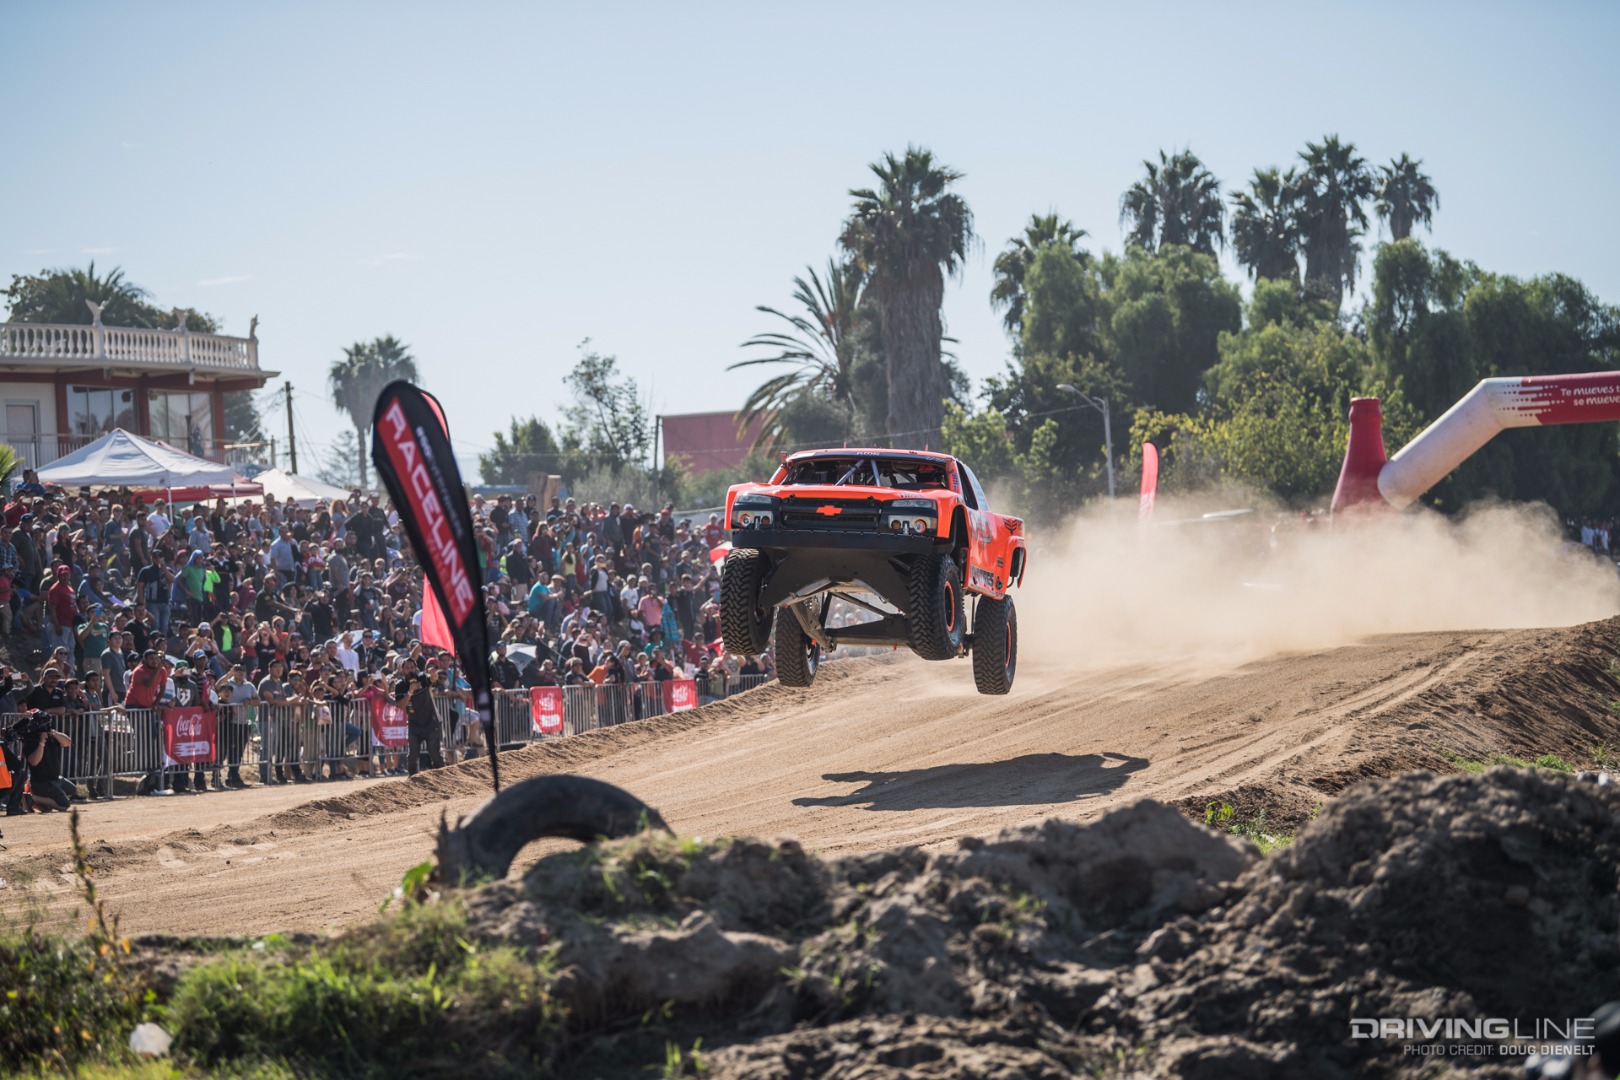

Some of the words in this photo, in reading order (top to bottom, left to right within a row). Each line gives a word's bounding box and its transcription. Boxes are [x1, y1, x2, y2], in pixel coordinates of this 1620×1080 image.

[1560, 388, 1571, 397] Te
[1573, 385, 1614, 395] mueves
[1573, 398, 1584, 406] se
[385, 402, 473, 612] RACELINE
